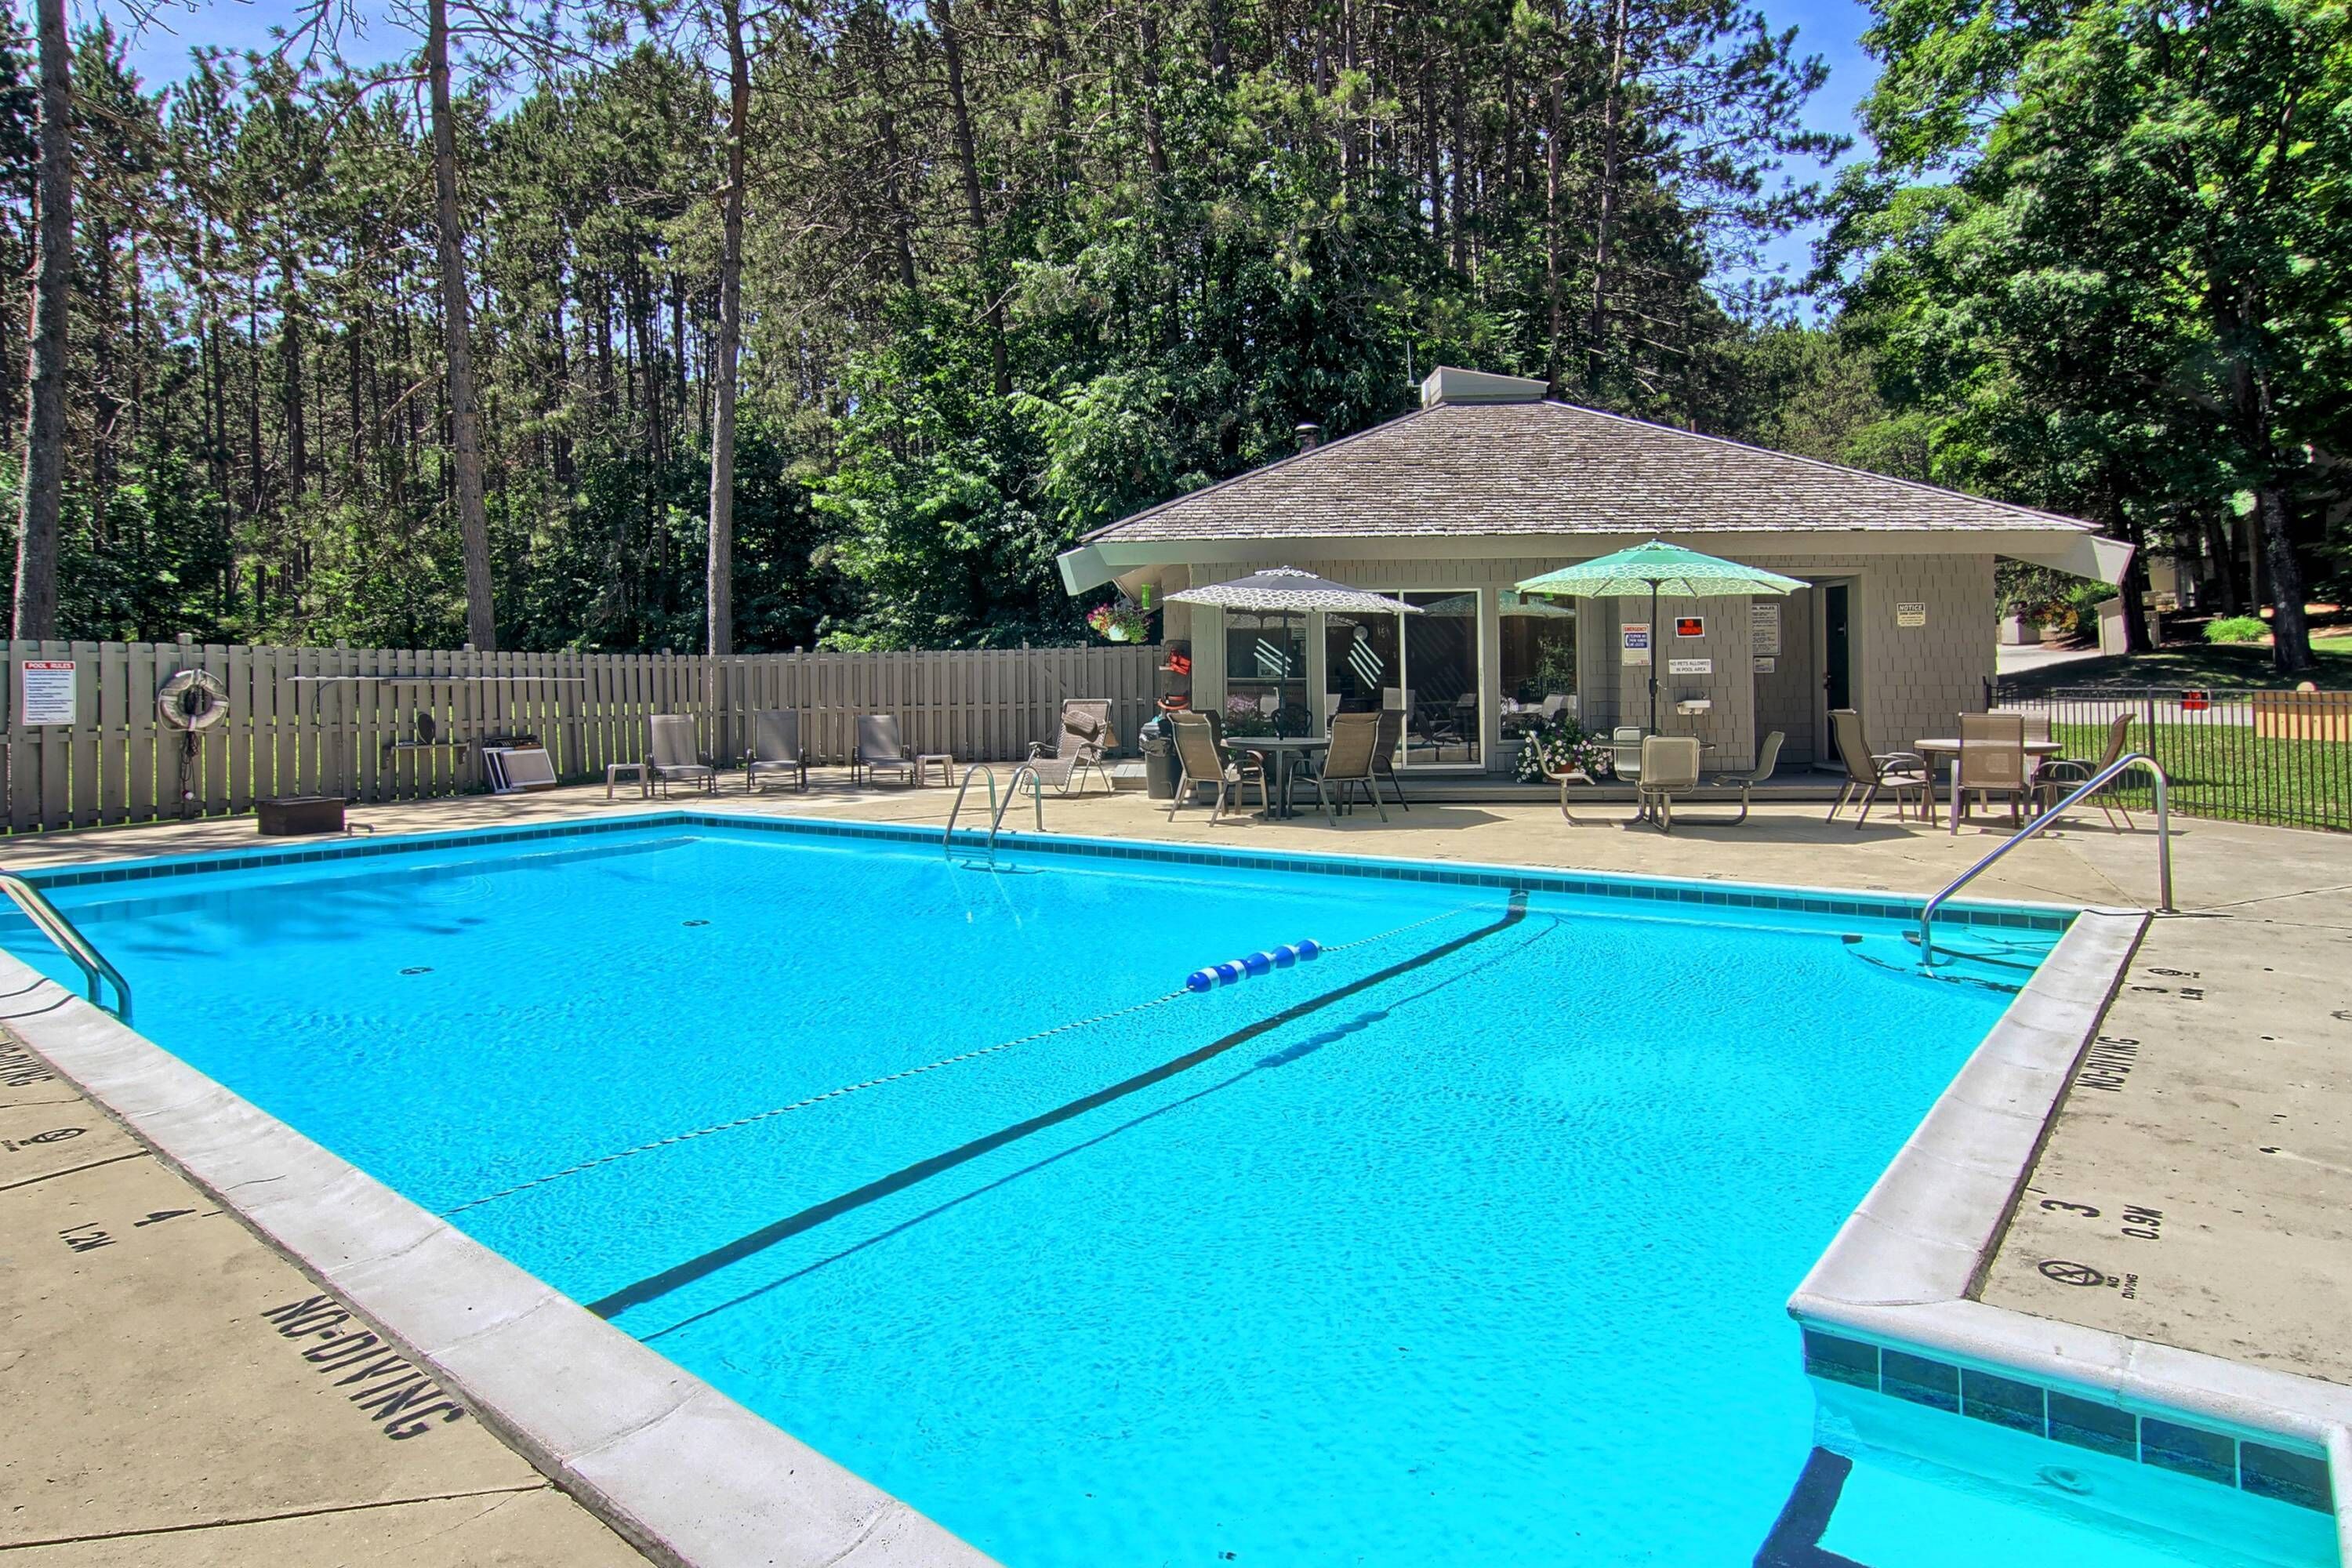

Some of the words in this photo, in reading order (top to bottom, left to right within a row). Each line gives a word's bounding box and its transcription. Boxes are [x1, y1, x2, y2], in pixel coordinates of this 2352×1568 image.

[2074, 1036, 2140, 1092] NO-DIVING
[133, 1208, 197, 1228] 4
[2040, 1200, 2101, 1218] 3
[2121, 1204, 2164, 1240] 0.9M
[58, 1221, 117, 1253] 1.2M
[2107, 1276, 2120, 1289] NO
[2122, 1273, 2139, 1300] DIVING
[259, 1294, 464, 1440] NO-DIVING
